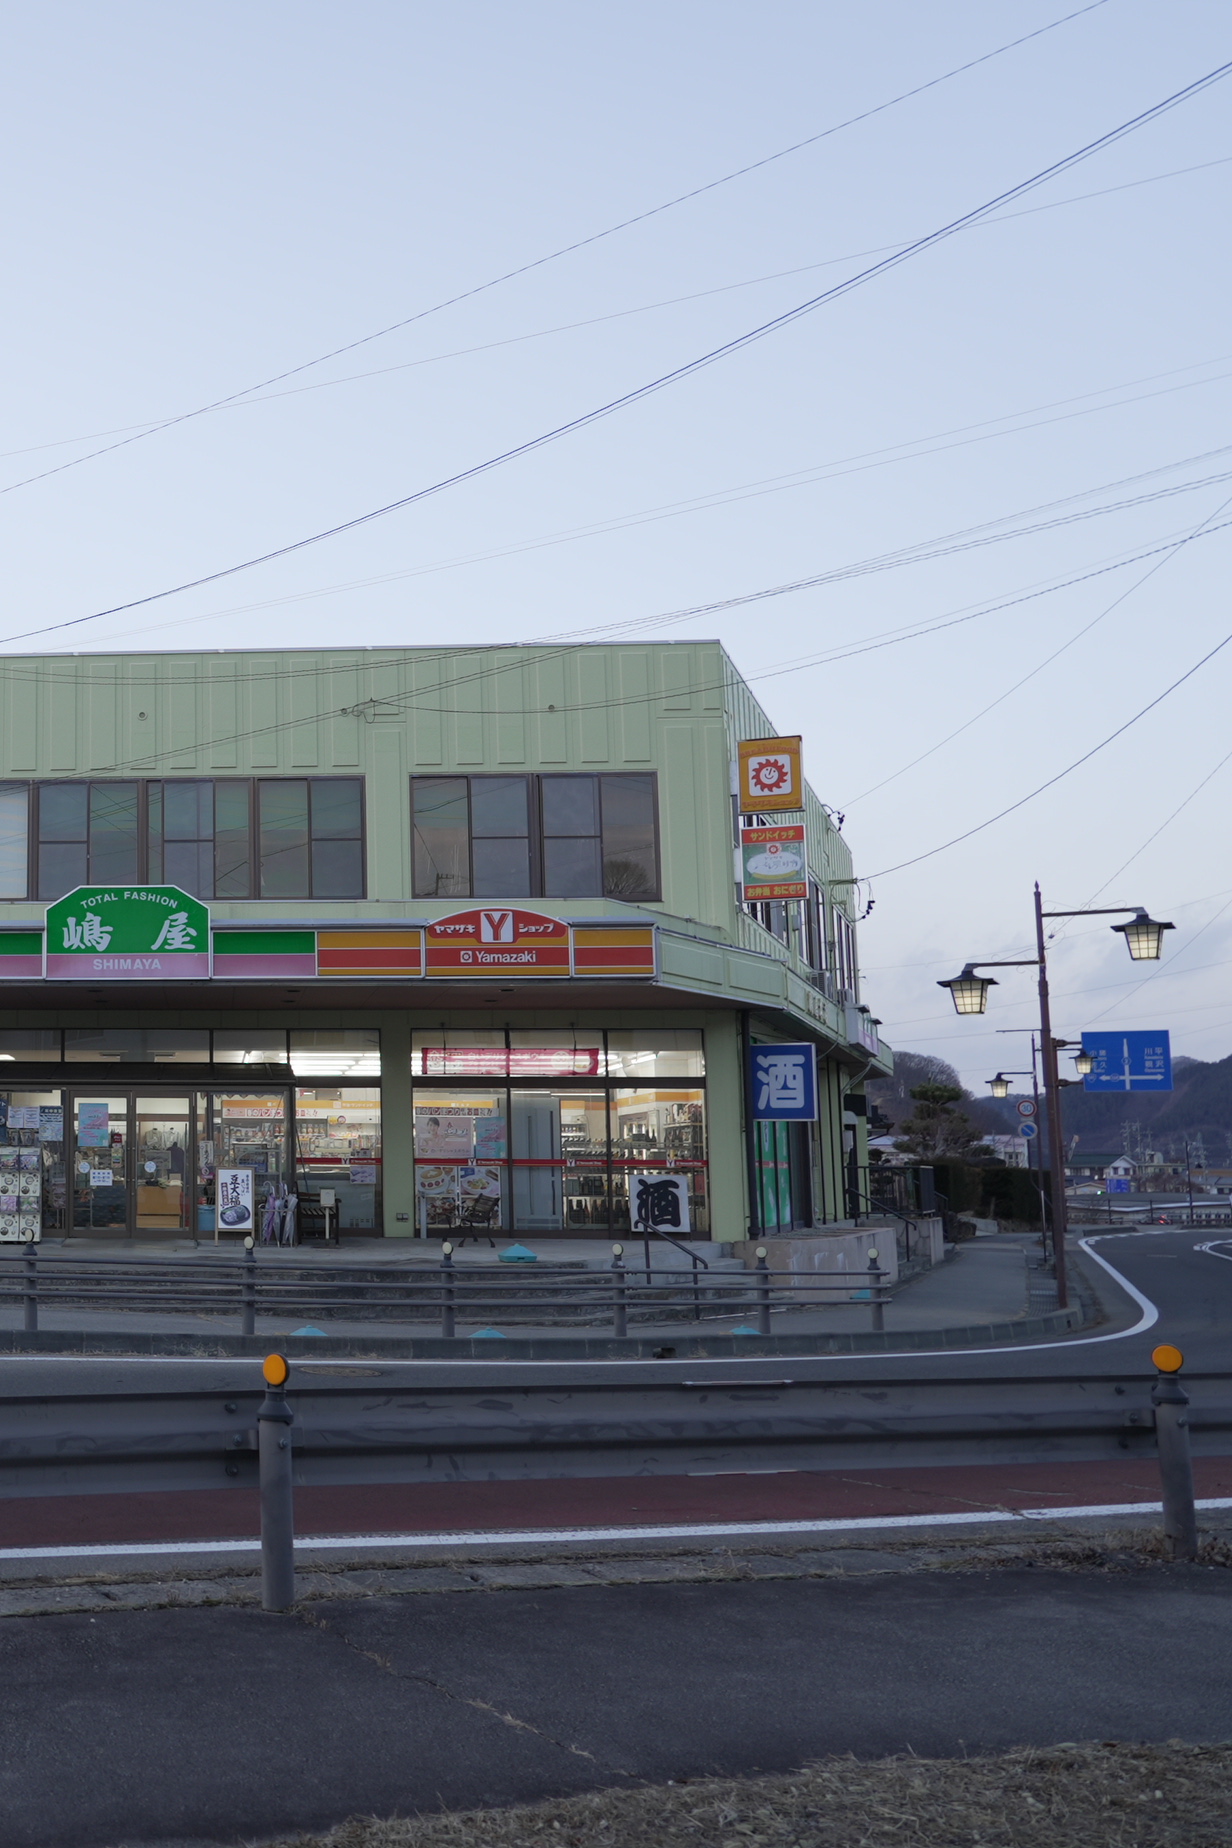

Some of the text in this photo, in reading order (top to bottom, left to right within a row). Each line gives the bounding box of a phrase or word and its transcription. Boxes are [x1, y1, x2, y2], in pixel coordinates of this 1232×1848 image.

[750, 829, 796, 841] サンドイッチ
[747, 883, 804, 897] お弁当 おにぎり
[80, 891, 179, 909] TOTAL FASHION
[62, 911, 198, 952] 嶋屋
[434, 913, 555, 941] ヤマザキ Y ショップ
[93, 958, 162, 970] SHIMAYA
[476, 950, 537, 963] Yamazaki
[756, 1054, 805, 1111] 酒
[1021, 1104, 1032, 1113] 30
[229, 1174, 241, 1206] 豆大福
[636, 1178, 682, 1228] 酒
